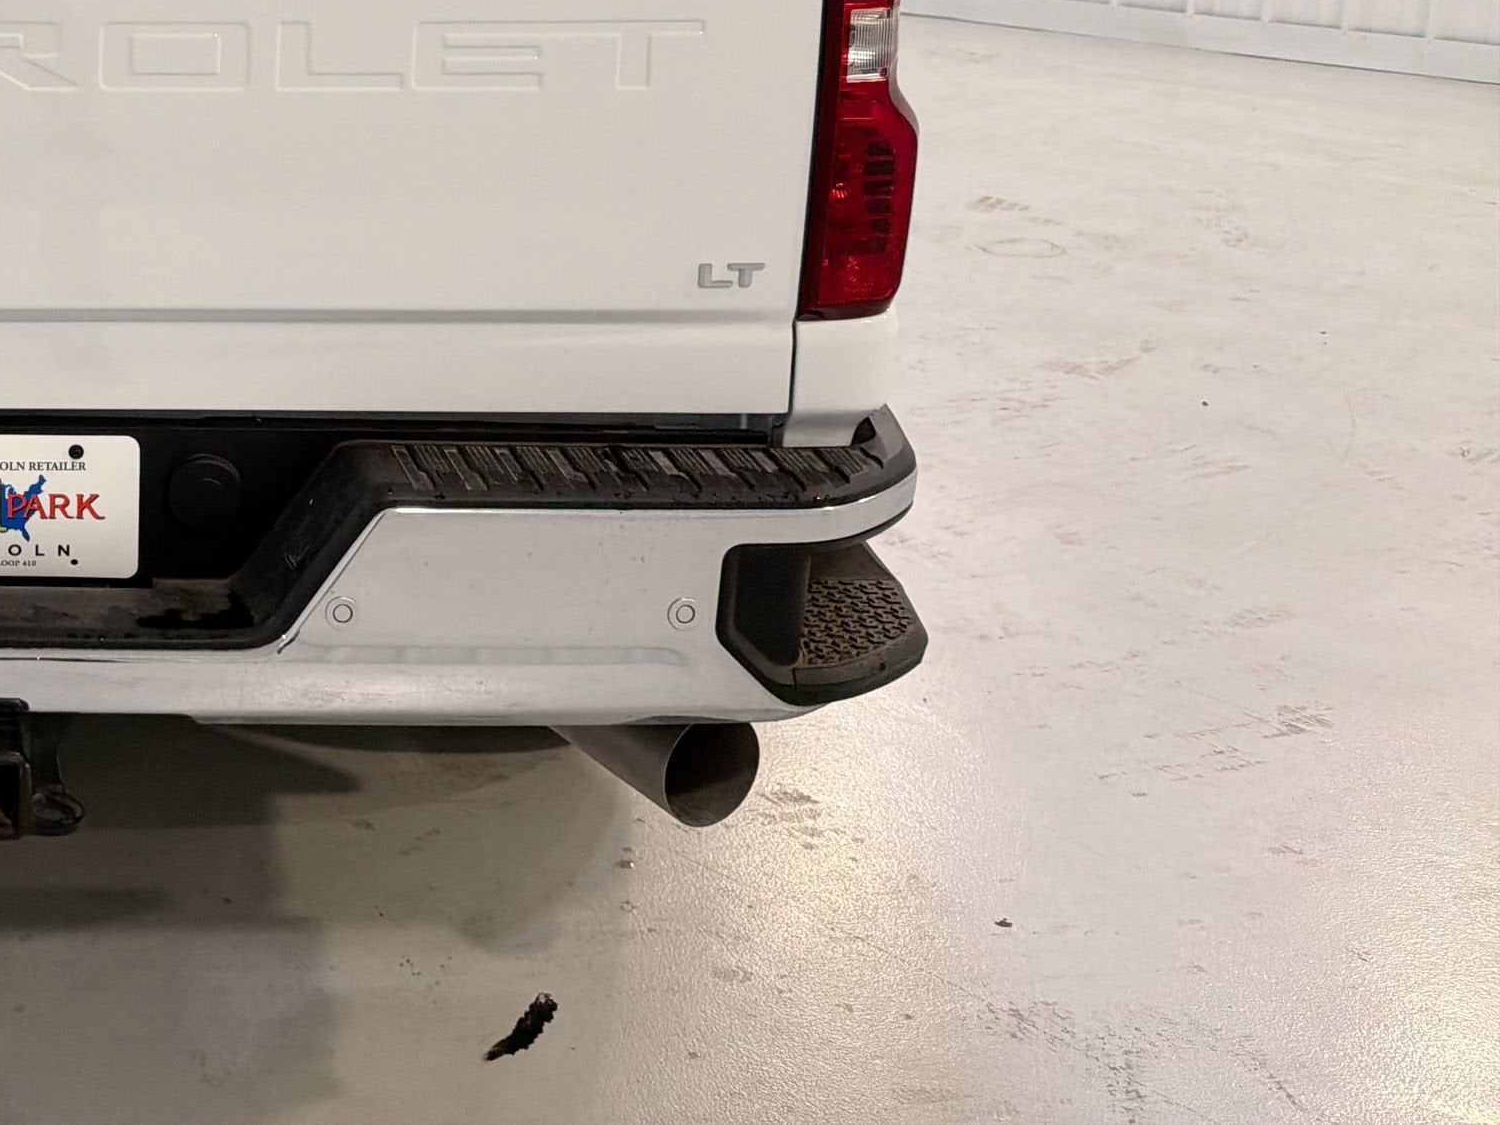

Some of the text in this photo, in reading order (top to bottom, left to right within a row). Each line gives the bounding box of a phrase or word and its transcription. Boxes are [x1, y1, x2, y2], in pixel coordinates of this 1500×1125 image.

[697, 262, 766, 289] LT
[28, 461, 87, 472] RETAILER
[7, 492, 106, 521] PARK
[21, 559, 37, 568] 410
